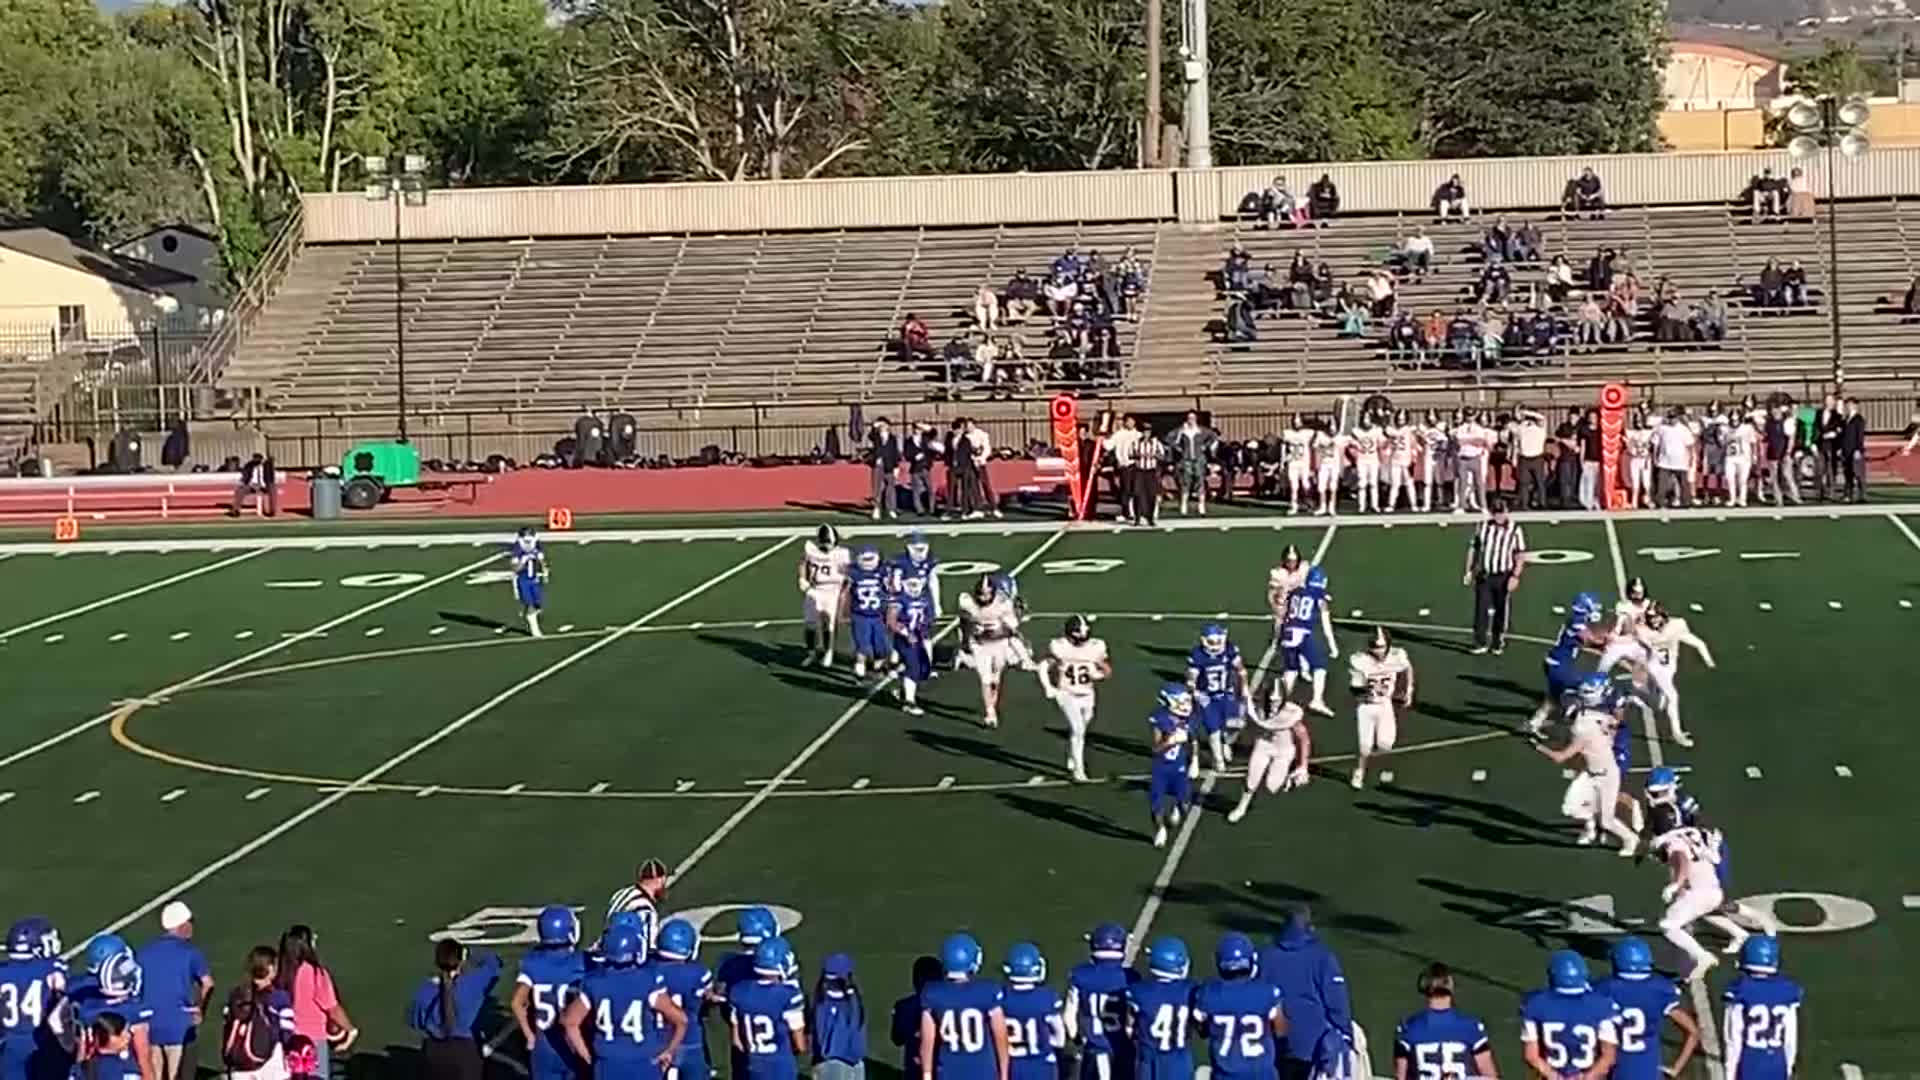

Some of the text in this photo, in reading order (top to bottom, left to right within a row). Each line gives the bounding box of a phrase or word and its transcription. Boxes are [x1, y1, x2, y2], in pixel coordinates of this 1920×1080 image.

[0, 978, 43, 1028] 34
[595, 998, 643, 1043] 44
[744, 1014, 777, 1054] 12
[939, 1008, 985, 1054] 40
[1149, 1004, 1190, 1052] 41
[1214, 1014, 1265, 1058] 72
[1542, 1022, 1597, 1070] 53
[1414, 1043, 1467, 1080] 55
